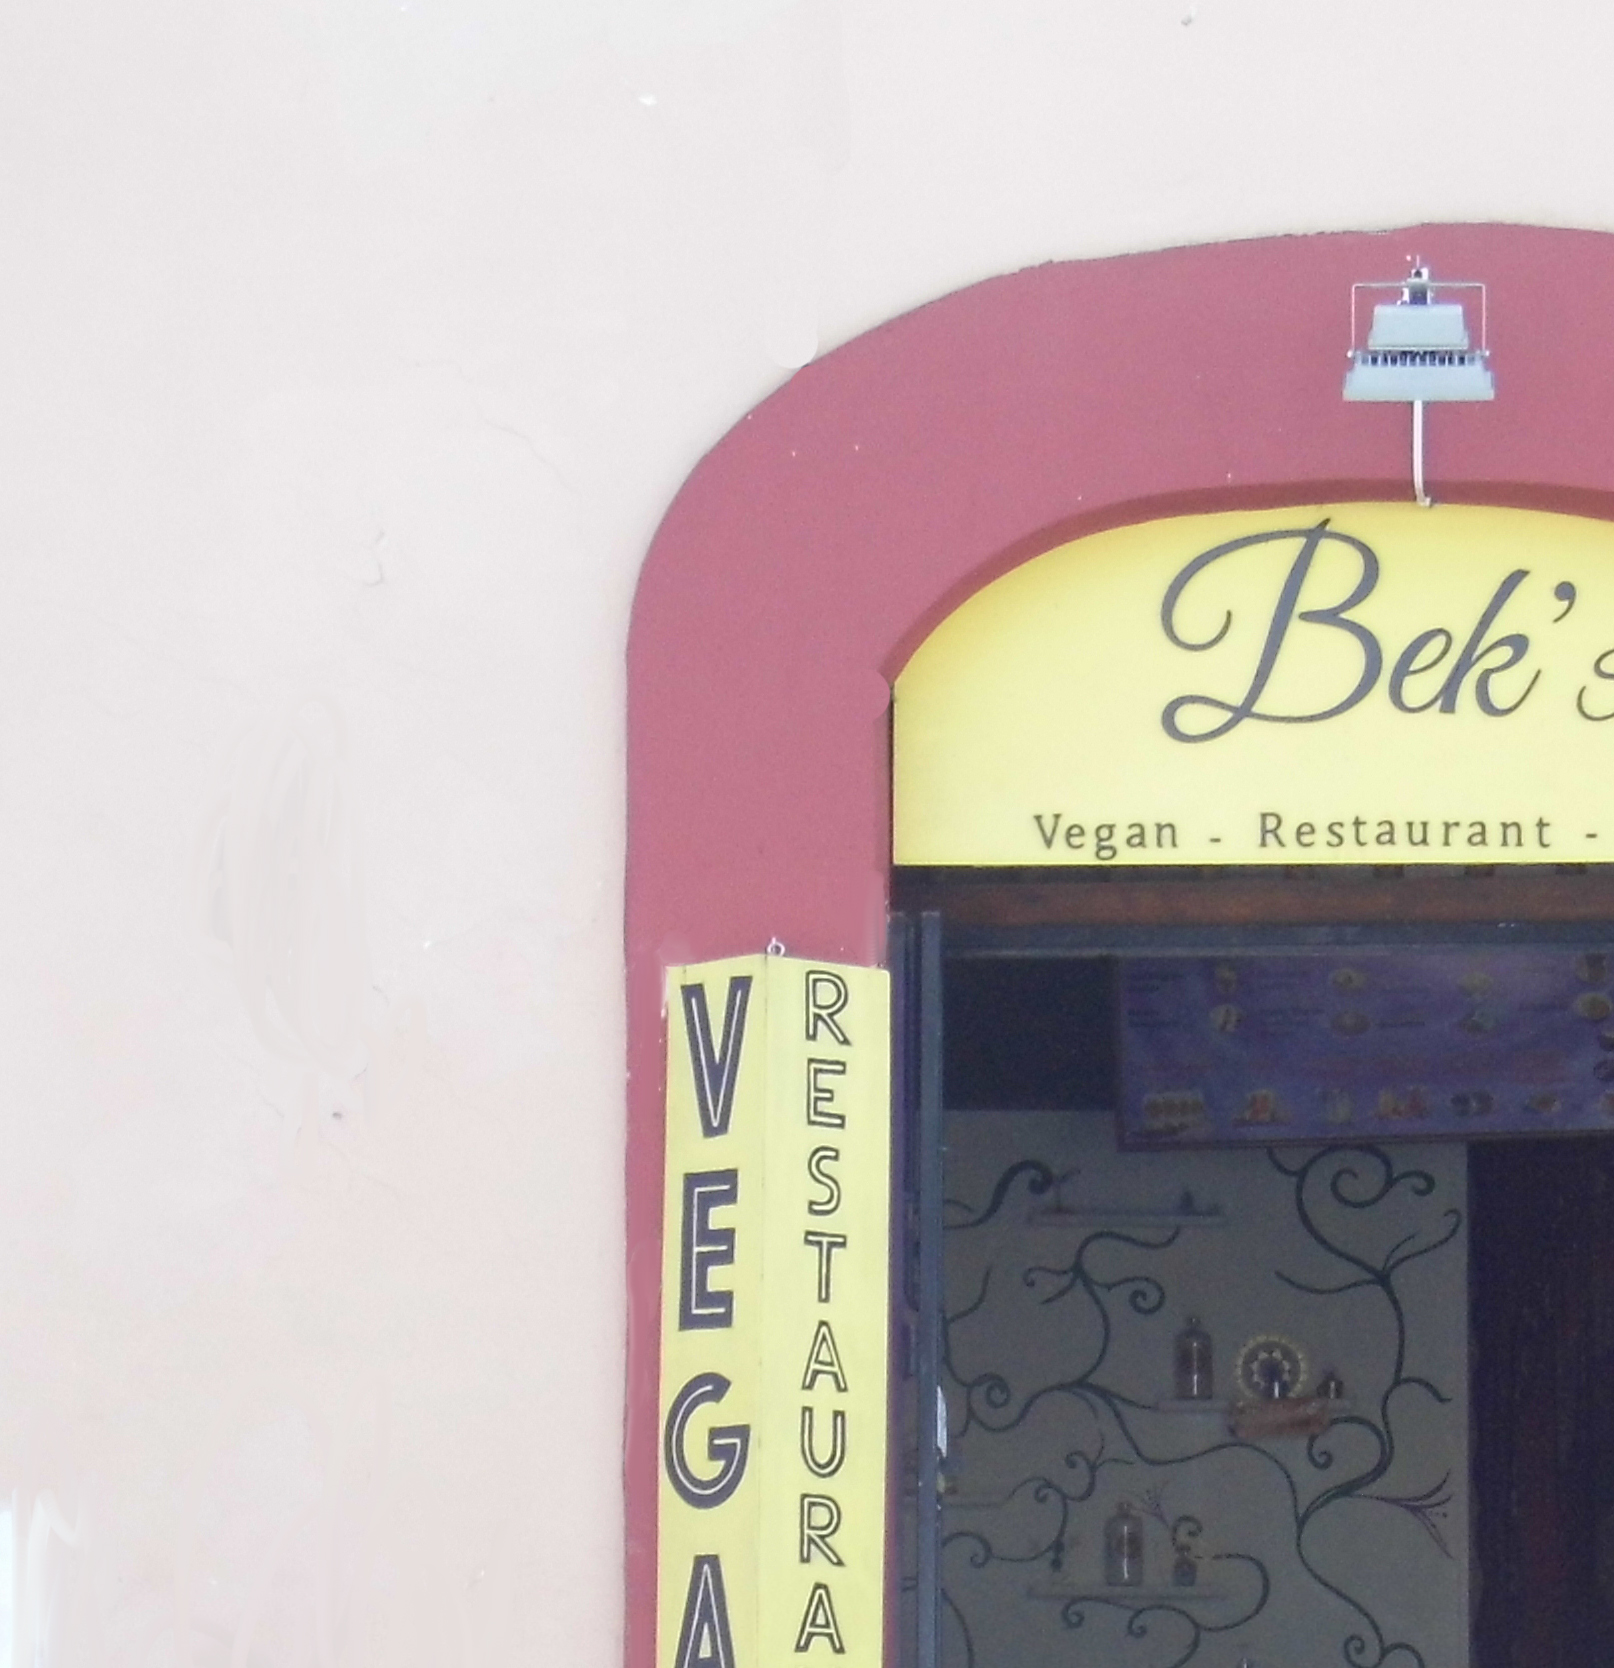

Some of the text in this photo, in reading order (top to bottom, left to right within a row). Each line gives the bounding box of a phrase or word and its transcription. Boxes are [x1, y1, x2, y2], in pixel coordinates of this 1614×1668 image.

[1160, 516, 1577, 743] Bek'
[1034, 812, 1181, 860] Vegan
[1259, 811, 1551, 850] Restaurant
